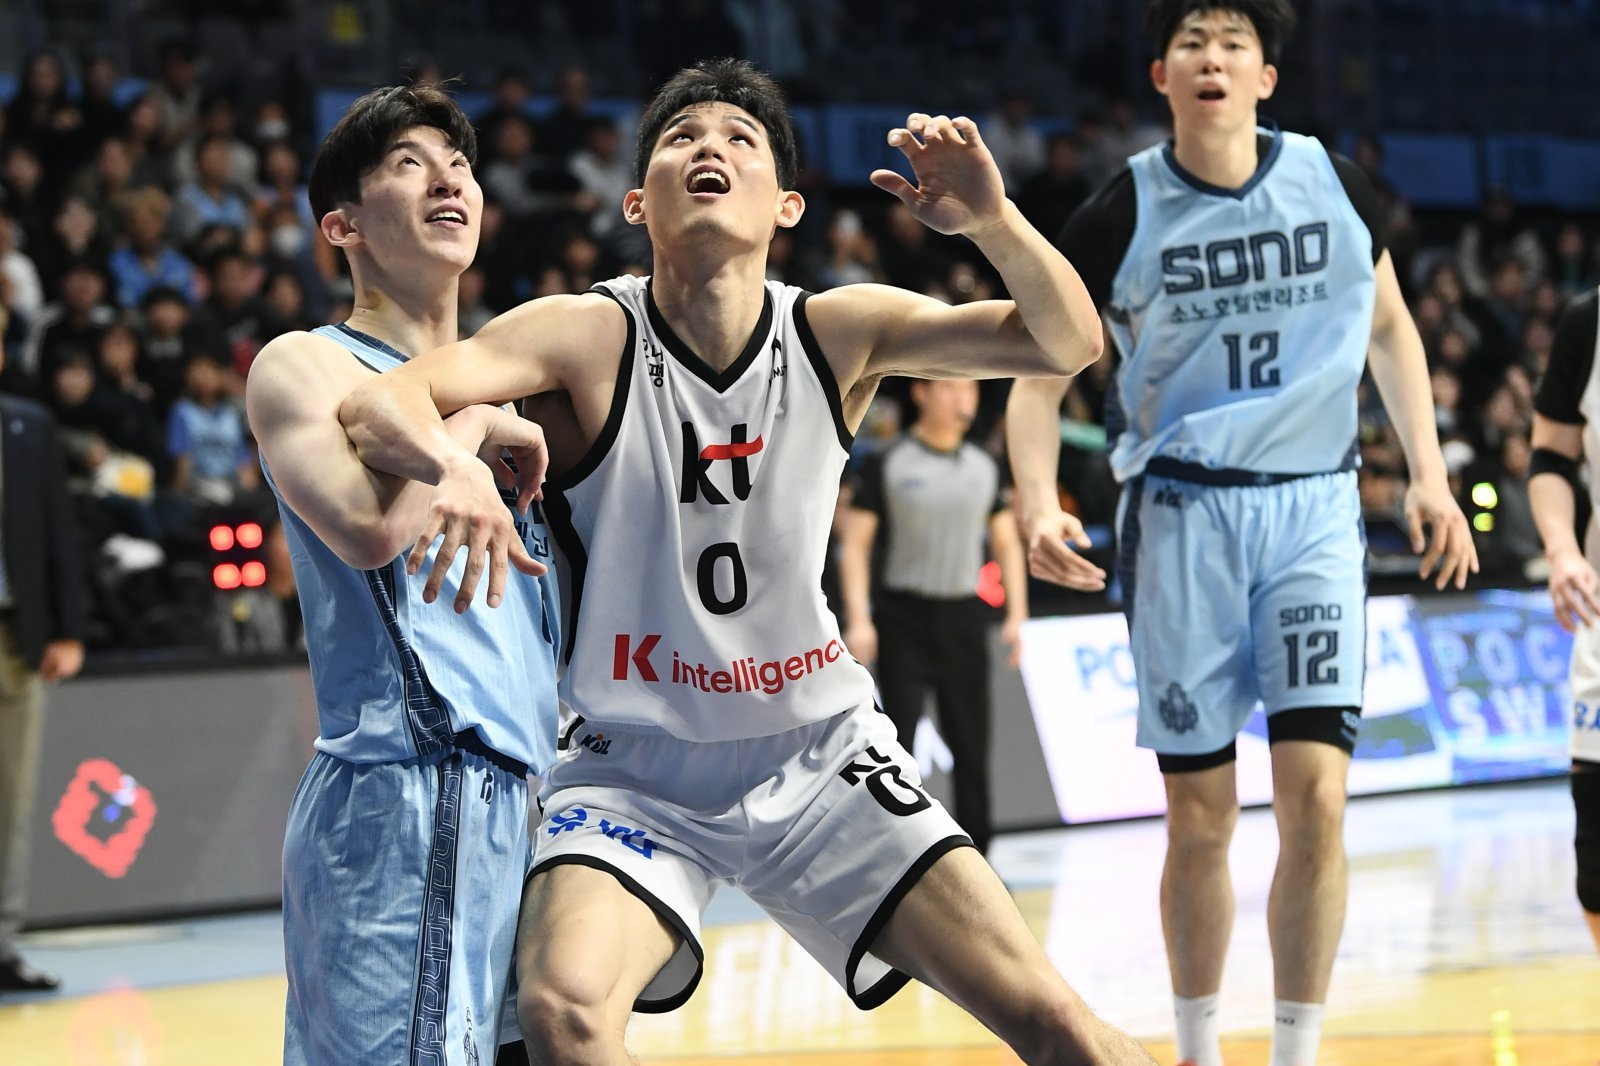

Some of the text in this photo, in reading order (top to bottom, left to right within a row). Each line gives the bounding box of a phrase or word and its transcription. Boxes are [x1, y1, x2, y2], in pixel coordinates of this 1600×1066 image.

[1169, 281, 1328, 324] 소노호텔앤리조트
[1222, 330, 1281, 391] 12
[680, 421, 763, 504] kt
[613, 634, 845, 694] K intelligenc
[1283, 630, 1339, 688] 12
